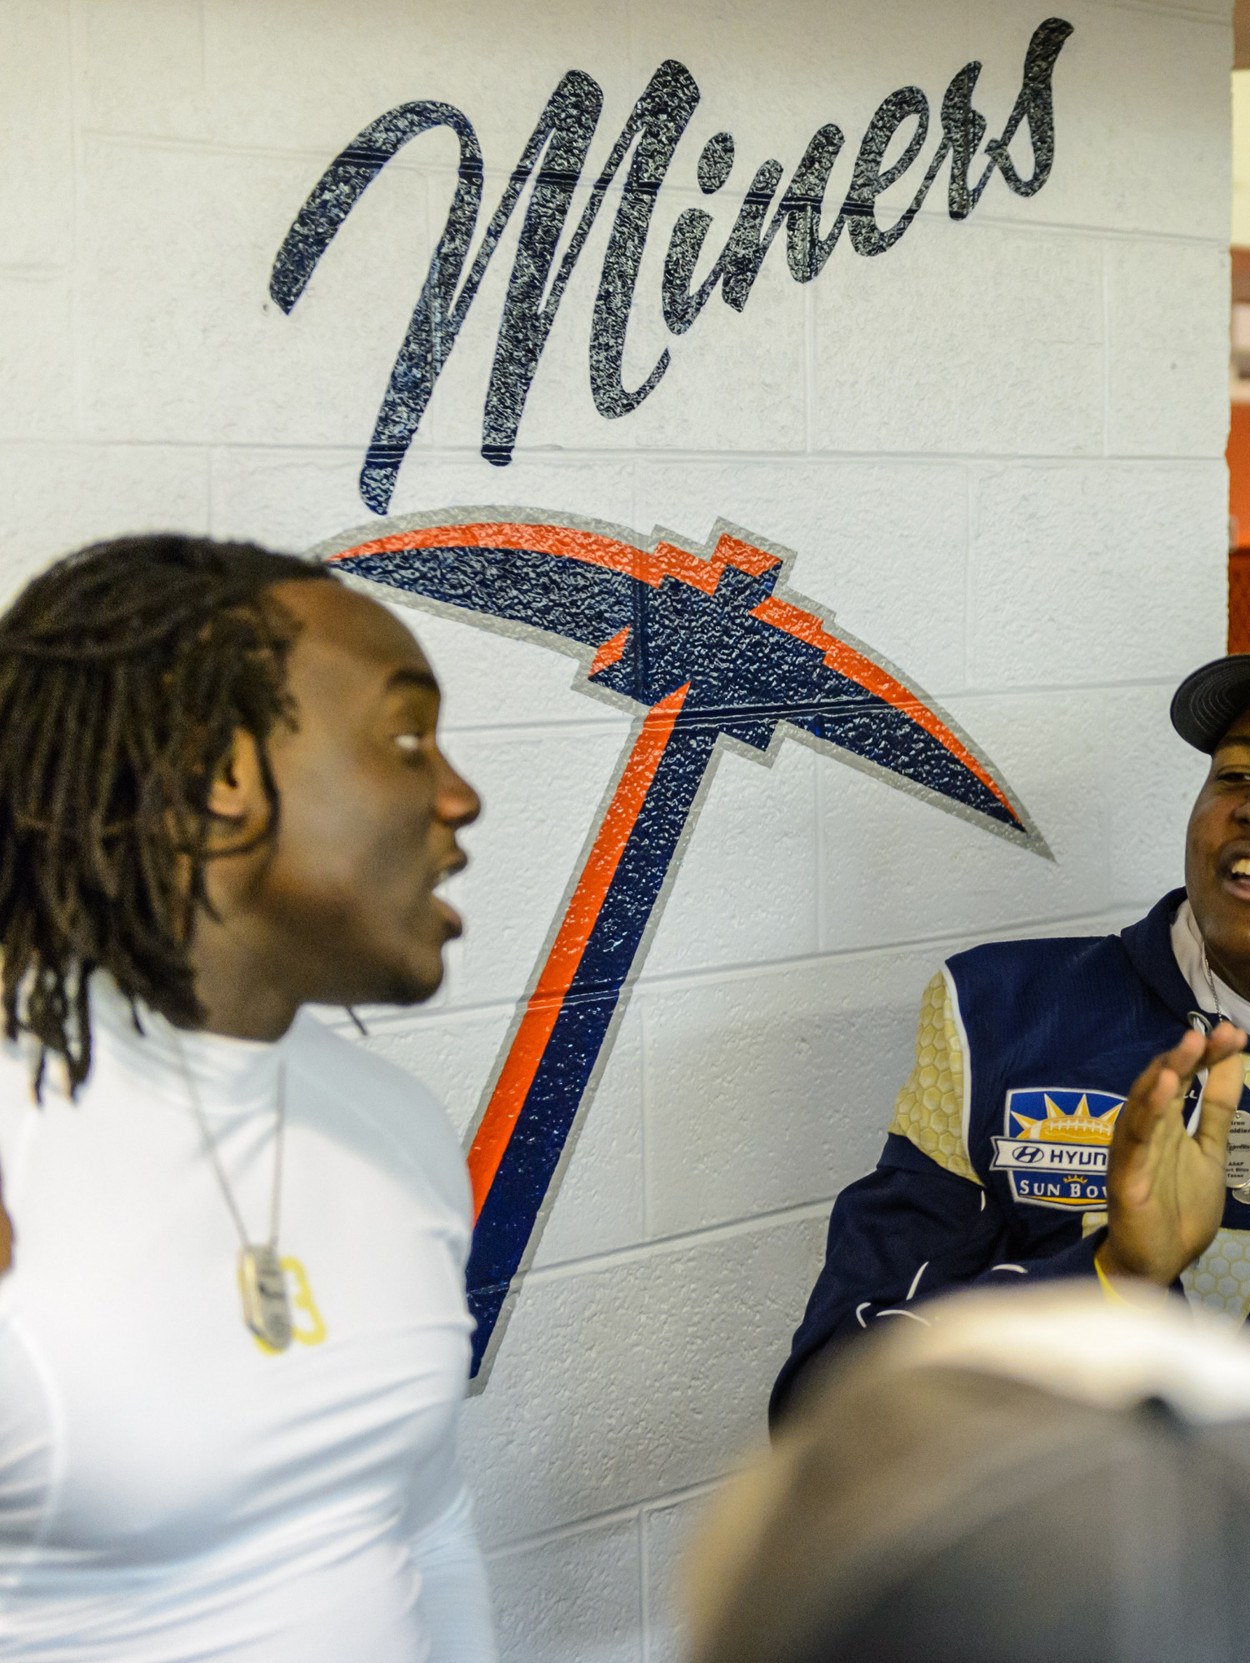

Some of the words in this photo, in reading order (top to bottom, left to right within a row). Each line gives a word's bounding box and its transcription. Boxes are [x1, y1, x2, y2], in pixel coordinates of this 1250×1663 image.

[269, 17, 1074, 516] Miners
[1050, 1149, 1107, 1166] HYUN
[1019, 1179, 1060, 1196] SUN
[1070, 1183, 1107, 1198] BO
